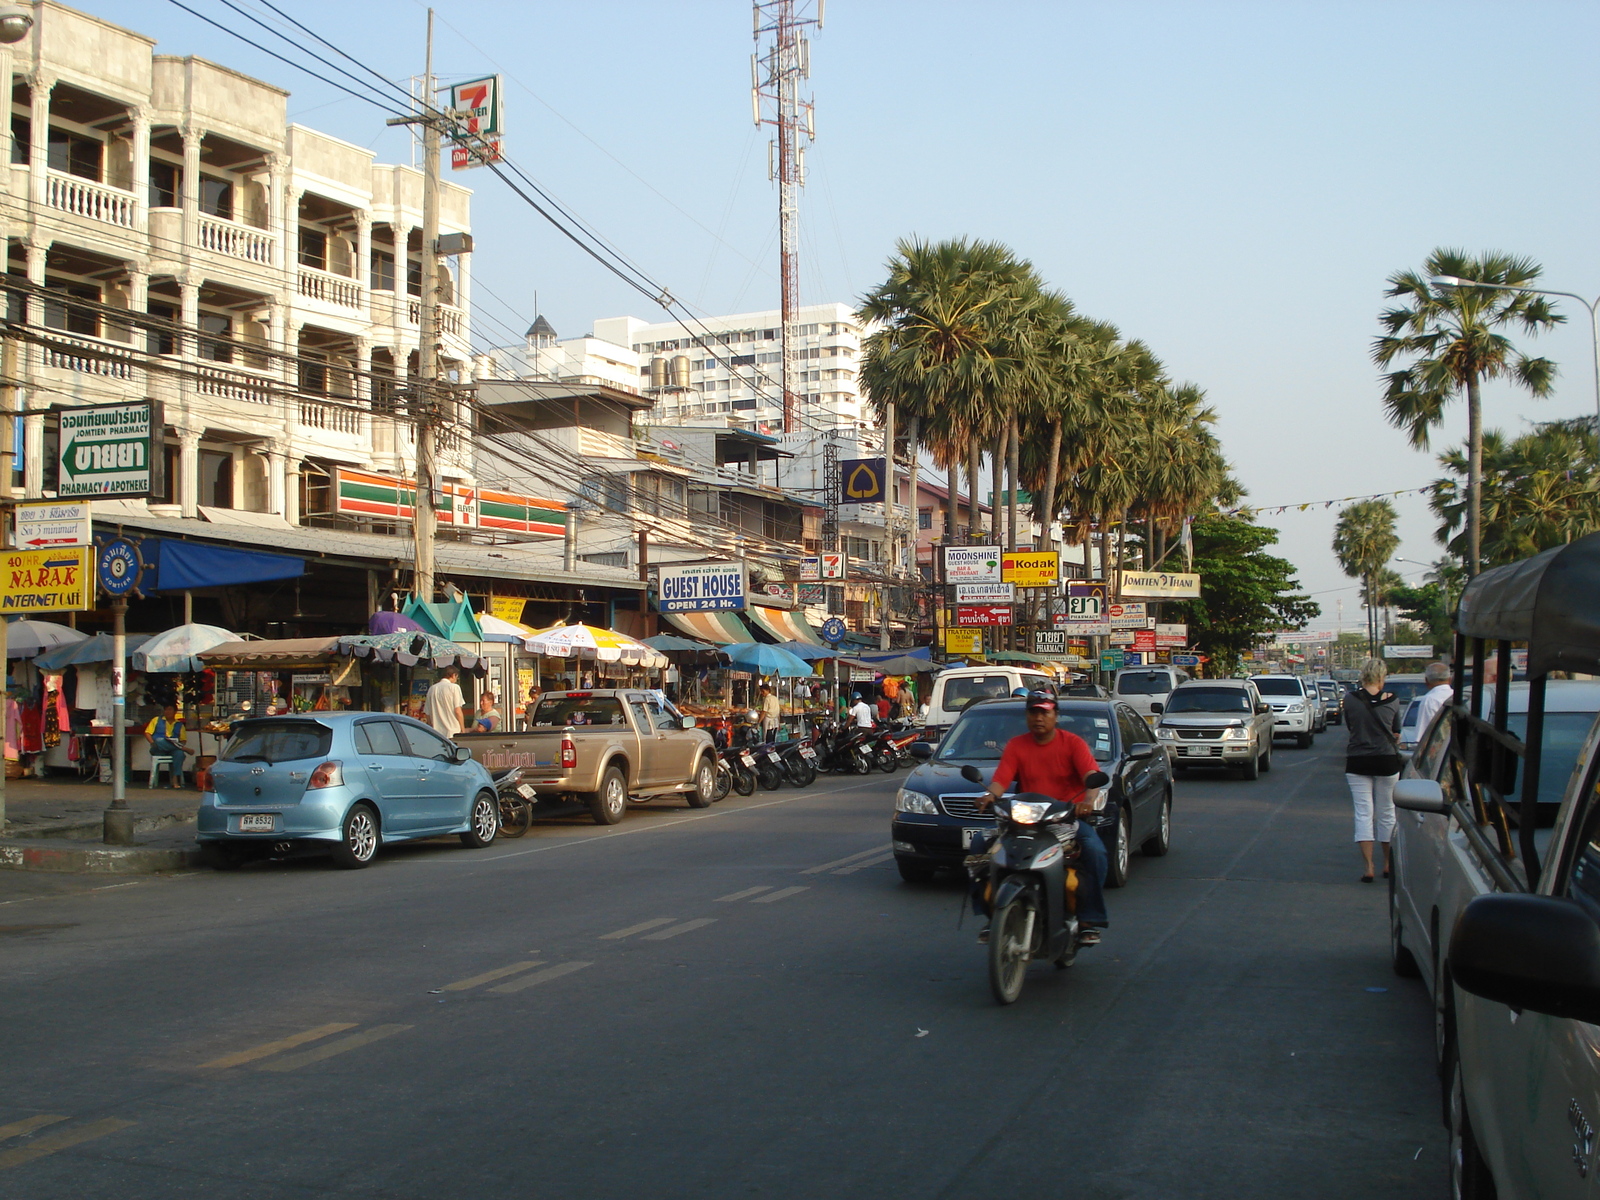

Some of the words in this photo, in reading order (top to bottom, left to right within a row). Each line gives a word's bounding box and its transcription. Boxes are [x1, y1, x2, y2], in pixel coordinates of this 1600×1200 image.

[459, 84, 487, 133] 7
[62, 405, 148, 428] จอมเทียนฟาร์มาซี
[76, 428, 106, 437] JOMTIEN
[109, 425, 148, 435] PHARMACY
[75, 441, 144, 471] ขายยา
[61, 482, 103, 495] PHARMACY
[110, 479, 148, 492] APOTHEKE
[458, 487, 474, 524] 7
[39, 509, 46, 519] 3
[21, 524, 33, 536] Soi
[43, 523, 78, 534] minimart
[102, 545, 134, 568] จอมเทียน
[948, 551, 998, 560] MOONSHINE
[115, 562, 122, 573] 3
[824, 555, 839, 577] 7
[1016, 560, 1055, 569] Kodak
[8, 566, 78, 588] NARAK
[105, 576, 131, 588] JOMTIEN
[1122, 574, 1159, 589] JOMTIEN
[1169, 576, 1193, 588] THANI
[663, 576, 699, 599] GUEST
[702, 574, 741, 597] HOUSE
[2, 593, 58, 608] INTERNET
[667, 601, 697, 610] OPEN
[701, 600, 717, 609] 24
[719, 599, 737, 608] Hr.
[1070, 597, 1099, 614] ยา
[1035, 631, 1065, 643] ขายยา
[1036, 644, 1064, 653] PHARMACY
[255, 816, 272, 825] 8532
